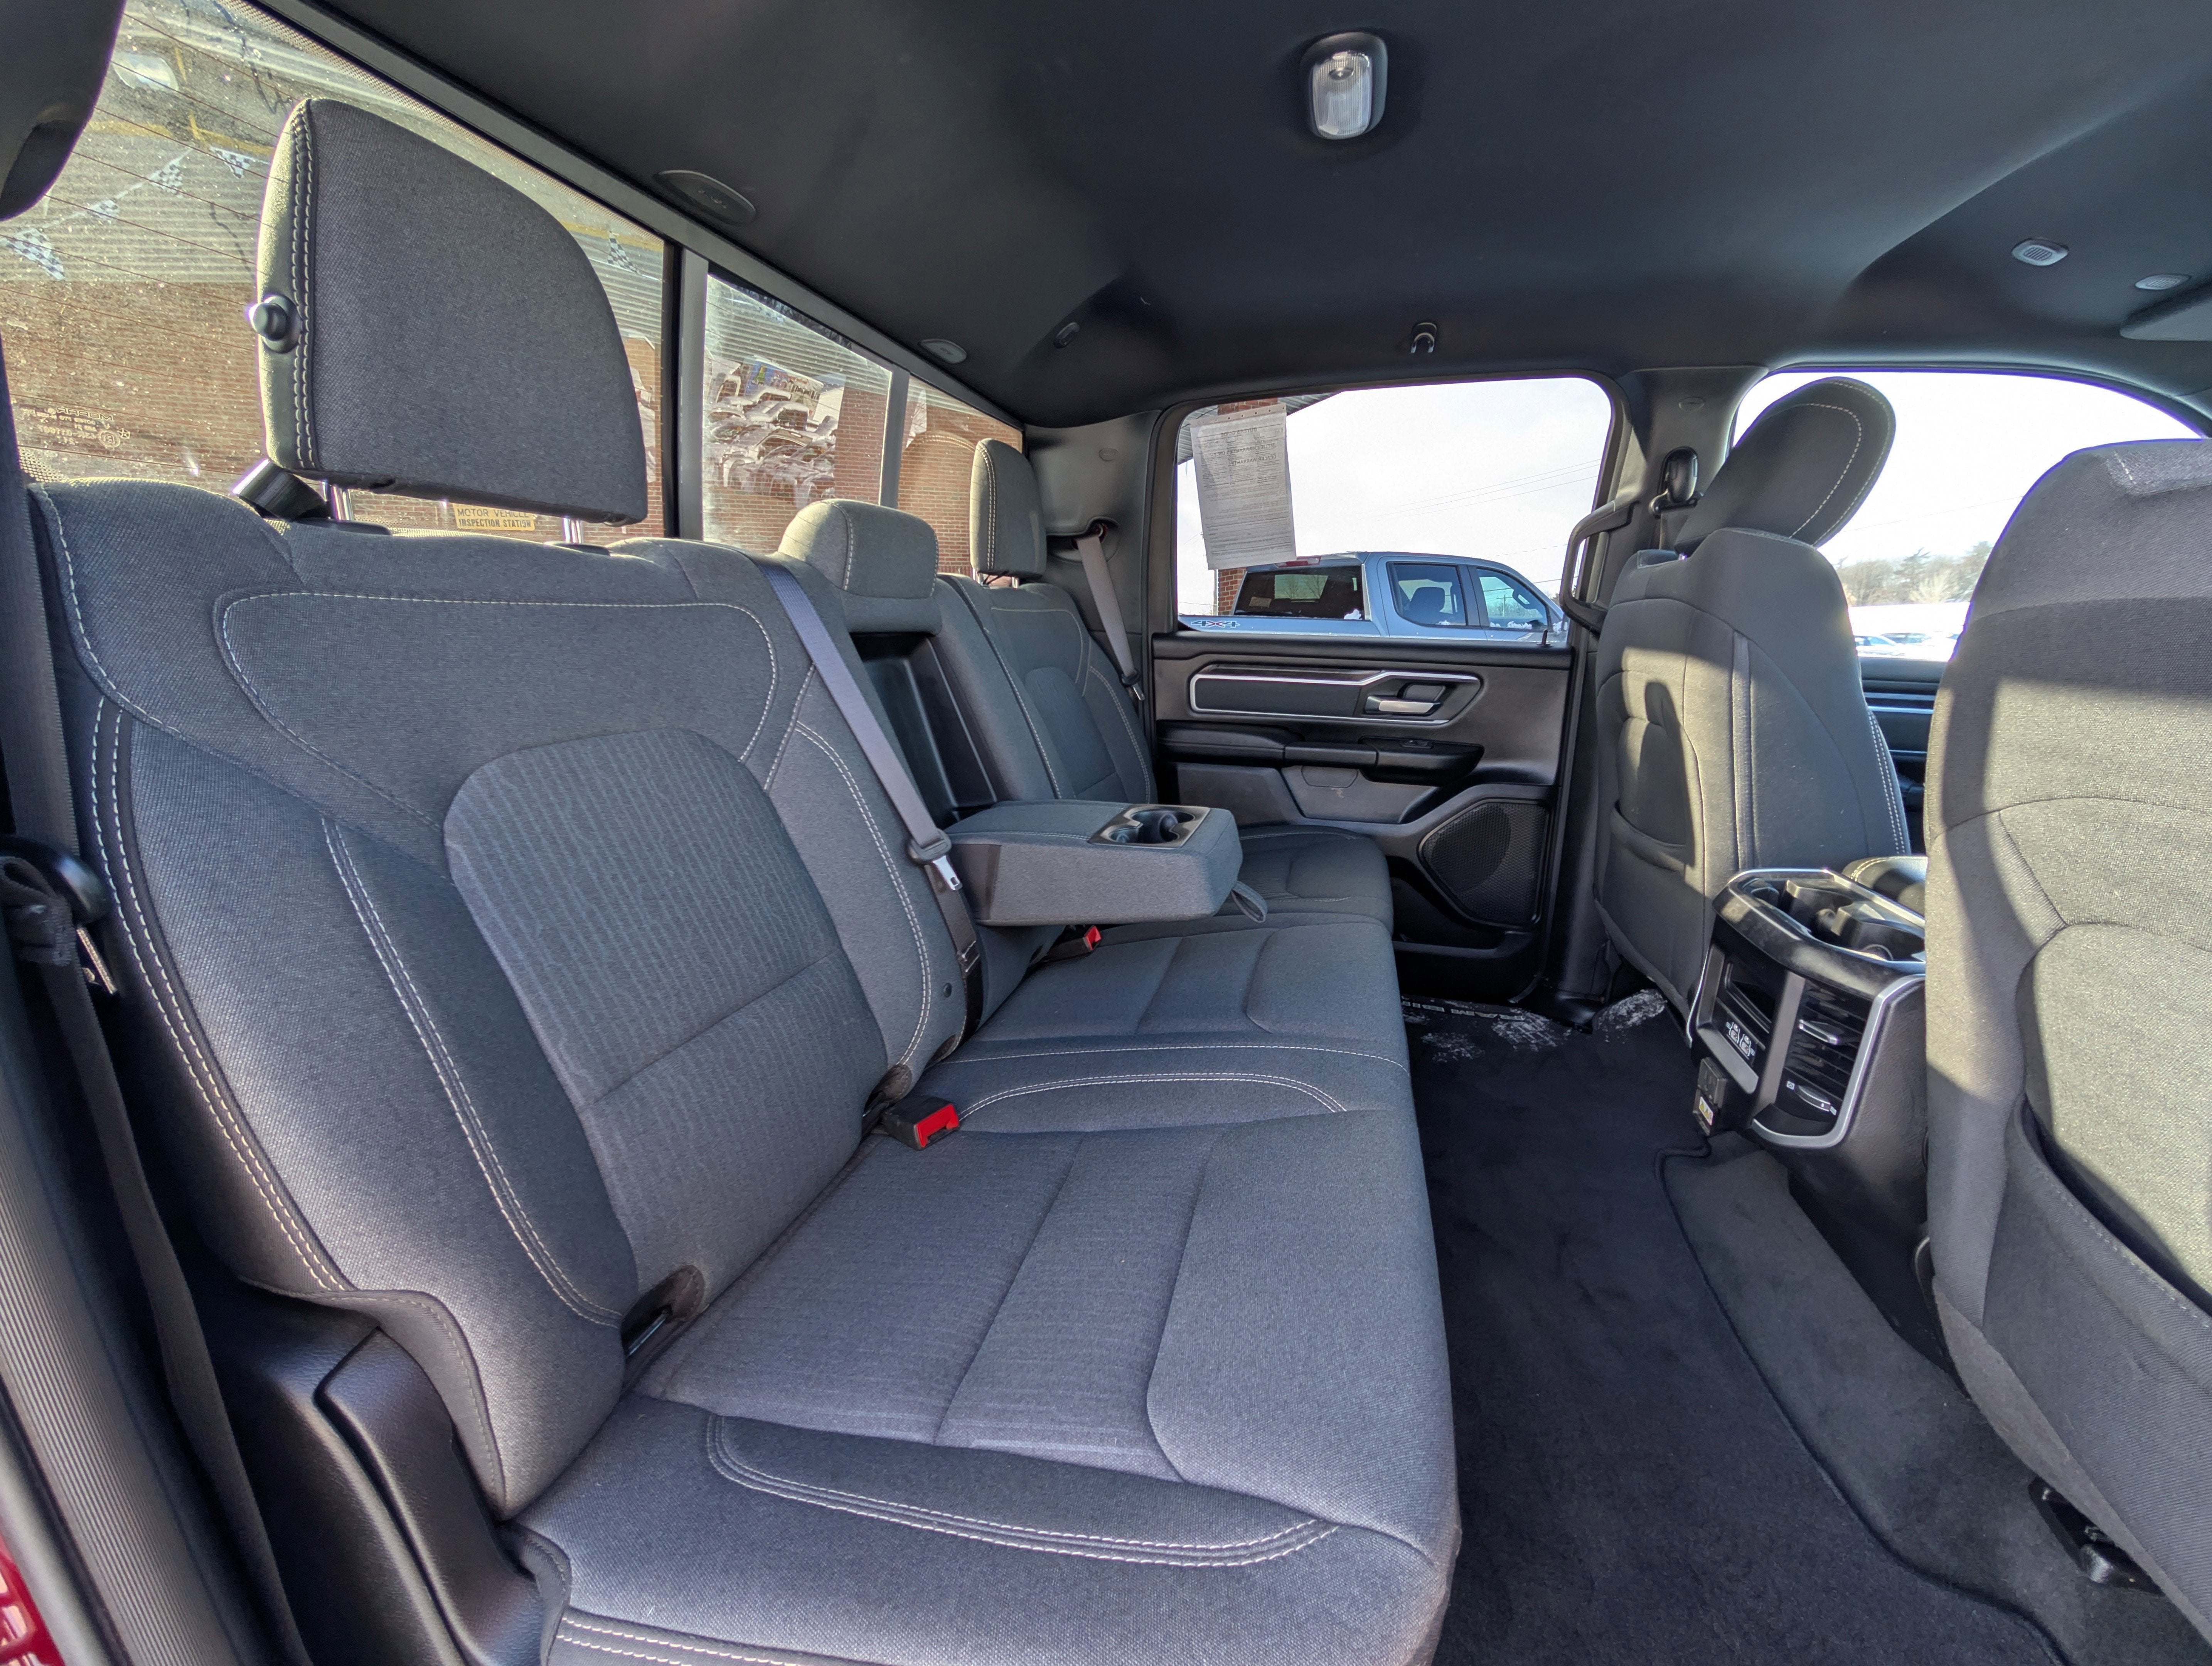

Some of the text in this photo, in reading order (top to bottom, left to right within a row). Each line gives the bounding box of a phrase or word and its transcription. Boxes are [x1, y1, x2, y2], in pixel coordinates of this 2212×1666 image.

[457, 508, 489, 517] MOTOR
[459, 519, 531, 528] INSPECTION STATION
